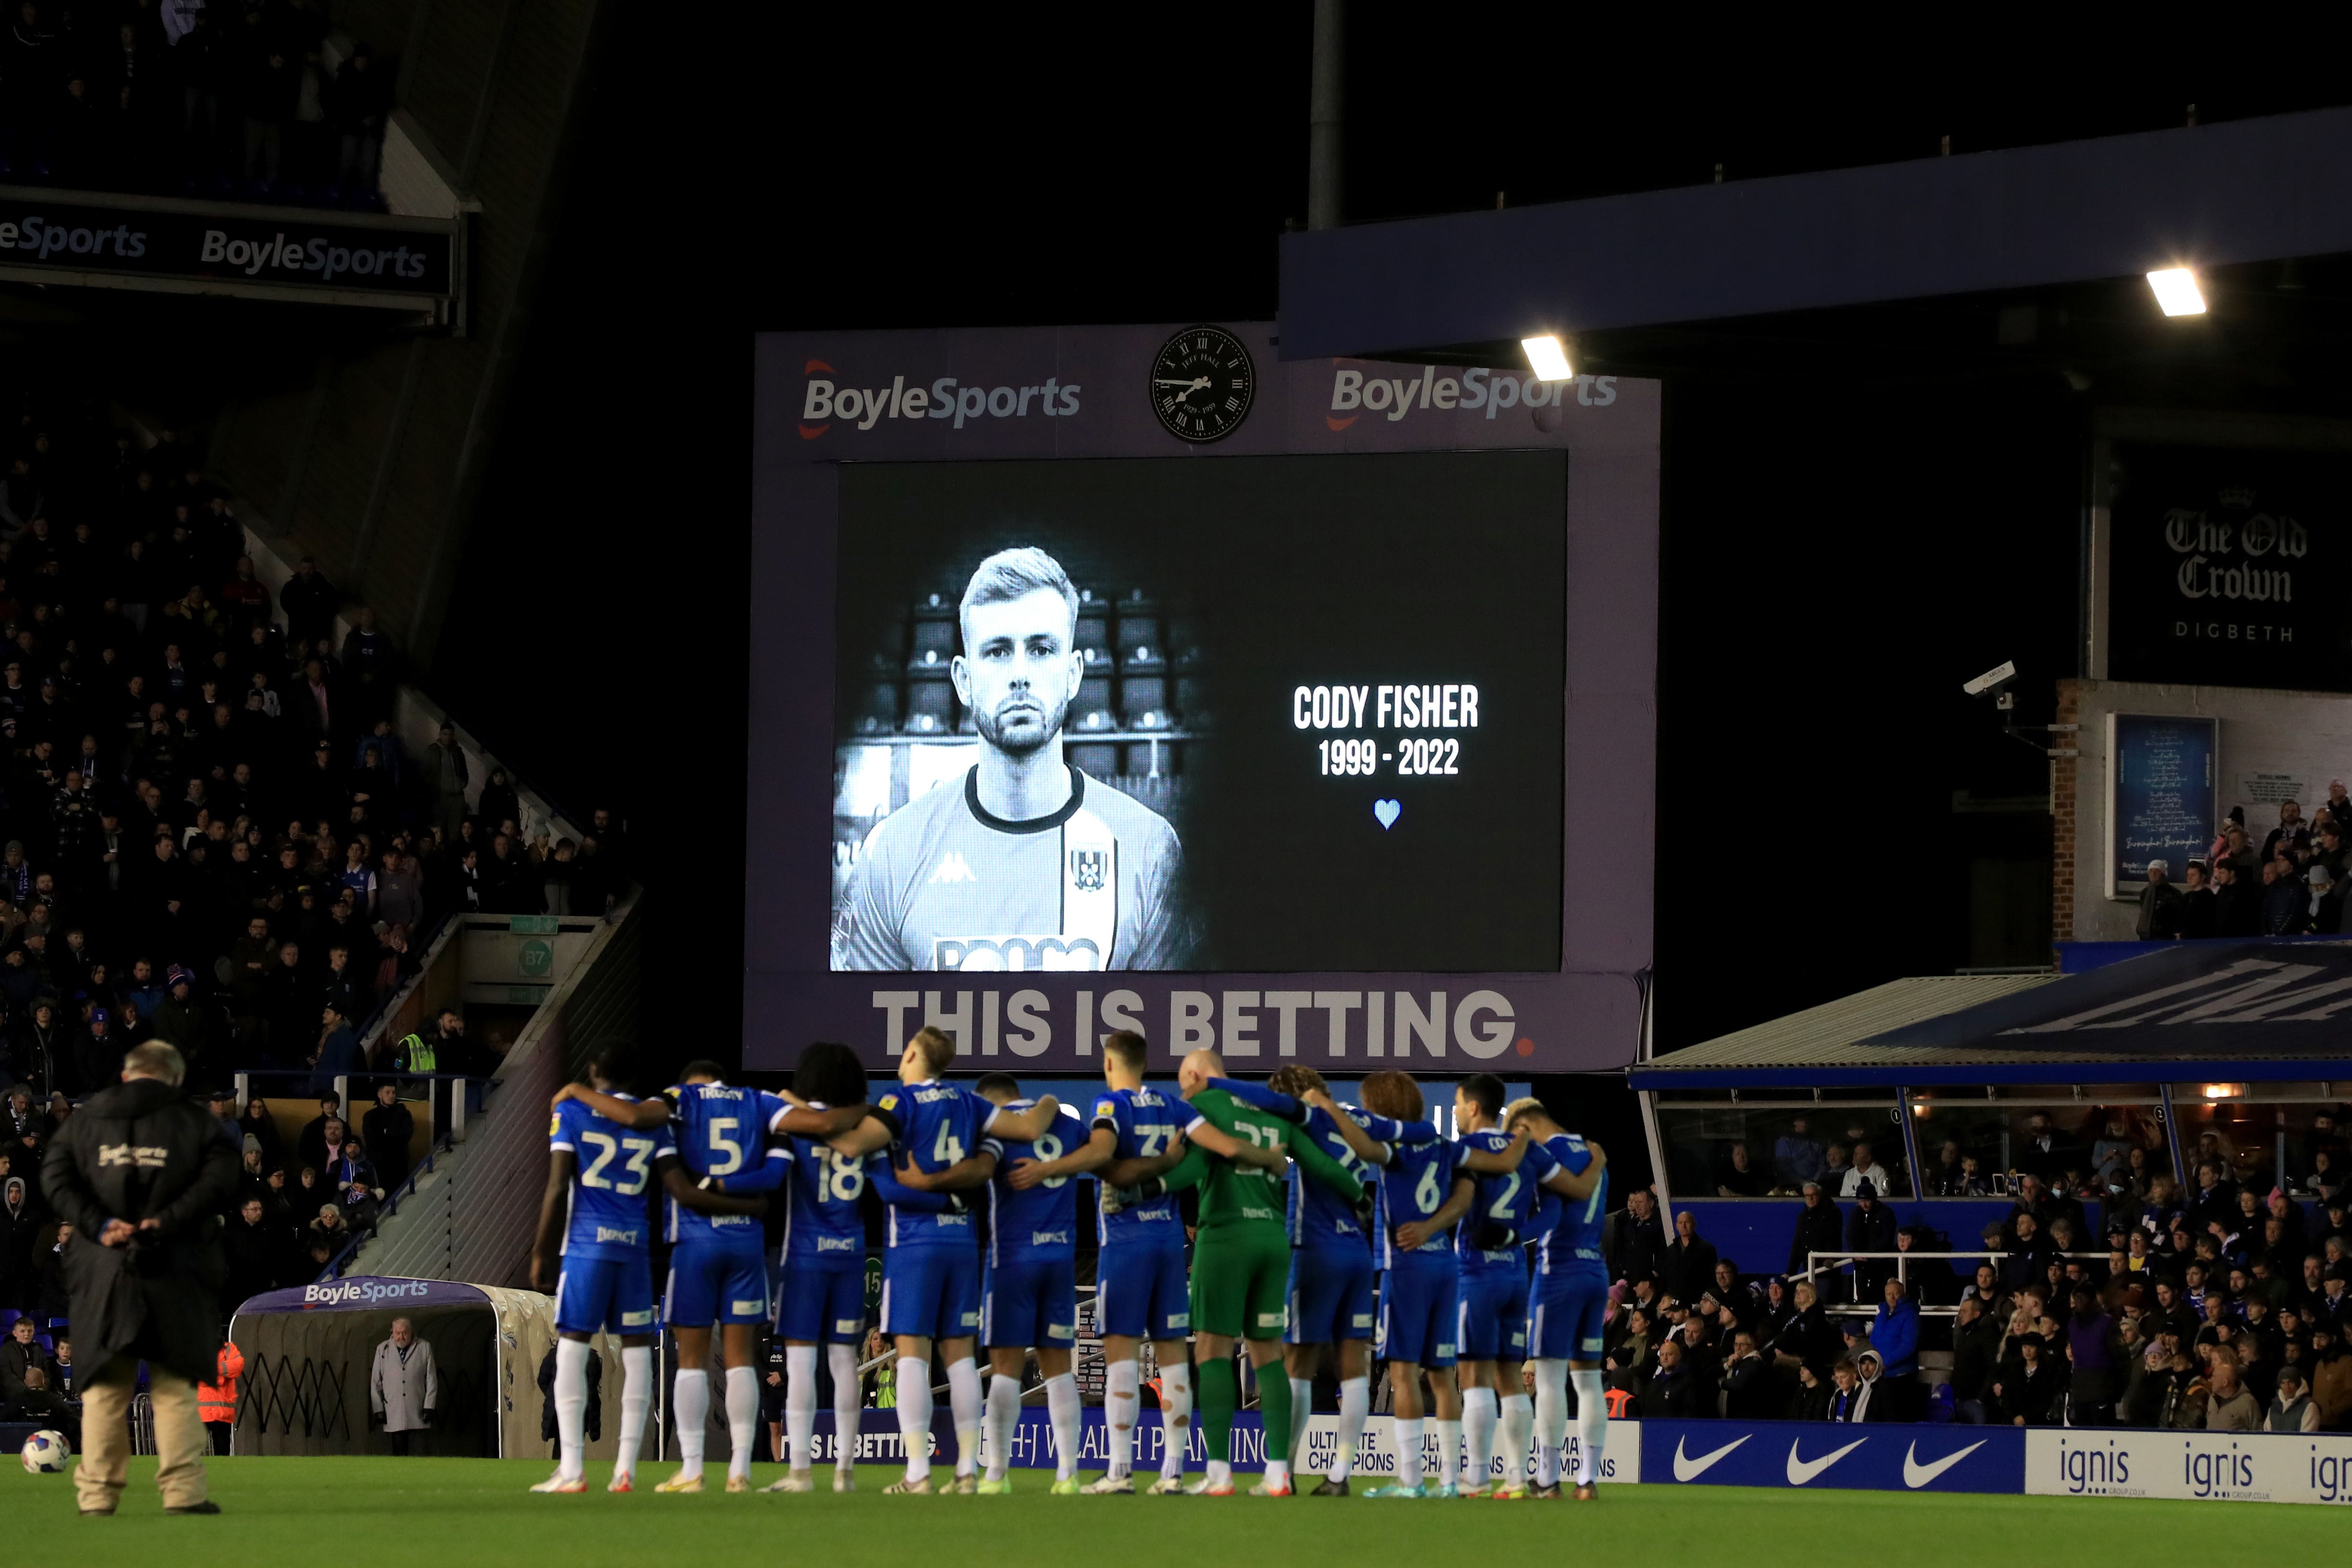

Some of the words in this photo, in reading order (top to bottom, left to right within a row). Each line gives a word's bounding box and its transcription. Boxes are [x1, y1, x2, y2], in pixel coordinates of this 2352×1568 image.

[201, 230, 426, 280] BoyleSports
[1180, 342, 1189, 355] XI
[1197, 338, 1207, 349] XII
[1166, 359, 1175, 369] X
[1182, 354, 1197, 369] JEFF
[1200, 353, 1220, 368] HALL
[1227, 359, 1239, 369] II
[1232, 379, 1243, 389] III
[1331, 365, 1616, 422] BoyleSports
[803, 376, 1081, 430] BoyleSports
[1163, 396, 1175, 414] VIII
[1183, 403, 1197, 414] 1929
[1203, 402, 1216, 414] 1959
[1175, 412, 1187, 427] VII
[1196, 419, 1205, 430] VI
[2164, 508, 2232, 553] The
[2242, 512, 2307, 558] Old
[2177, 554, 2292, 603] Crown
[2176, 622, 2292, 641] DIGBETH
[1294, 686, 1369, 729] CODY
[1377, 684, 1478, 728] FISHER
[1319, 739, 1376, 775] 1999
[1382, 753, 1392, 761] -
[1398, 738, 1459, 775] 2022
[873, 989, 1051, 1057] THIS
[1075, 989, 1162, 1057] IS
[709, 1118, 742, 1175] 5
[934, 1119, 966, 1167] 4
[581, 1132, 655, 1195] 23
[811, 1146, 864, 1202] 18
[1415, 1161, 1440, 1214] 6
[1489, 1170, 1521, 1218] 2
[596, 1226, 638, 1245] IMPACT
[818, 1236, 855, 1252] IMPACT
[304, 1279, 428, 1305] BoyleSports
[864, 1271, 881, 1293] 15
[853, 1432, 941, 1458] BETTIG.
[1310, 1431, 1376, 1450] ULTITE
[1309, 1451, 1394, 1471] CHAPIONS
[2062, 1438, 2129, 1493] ignis
[2186, 1441, 2253, 1497] ignis
[2109, 1487, 2146, 1496] GROUP.CO.UK
[2232, 1491, 2270, 1500] GROUP.CO.UK
